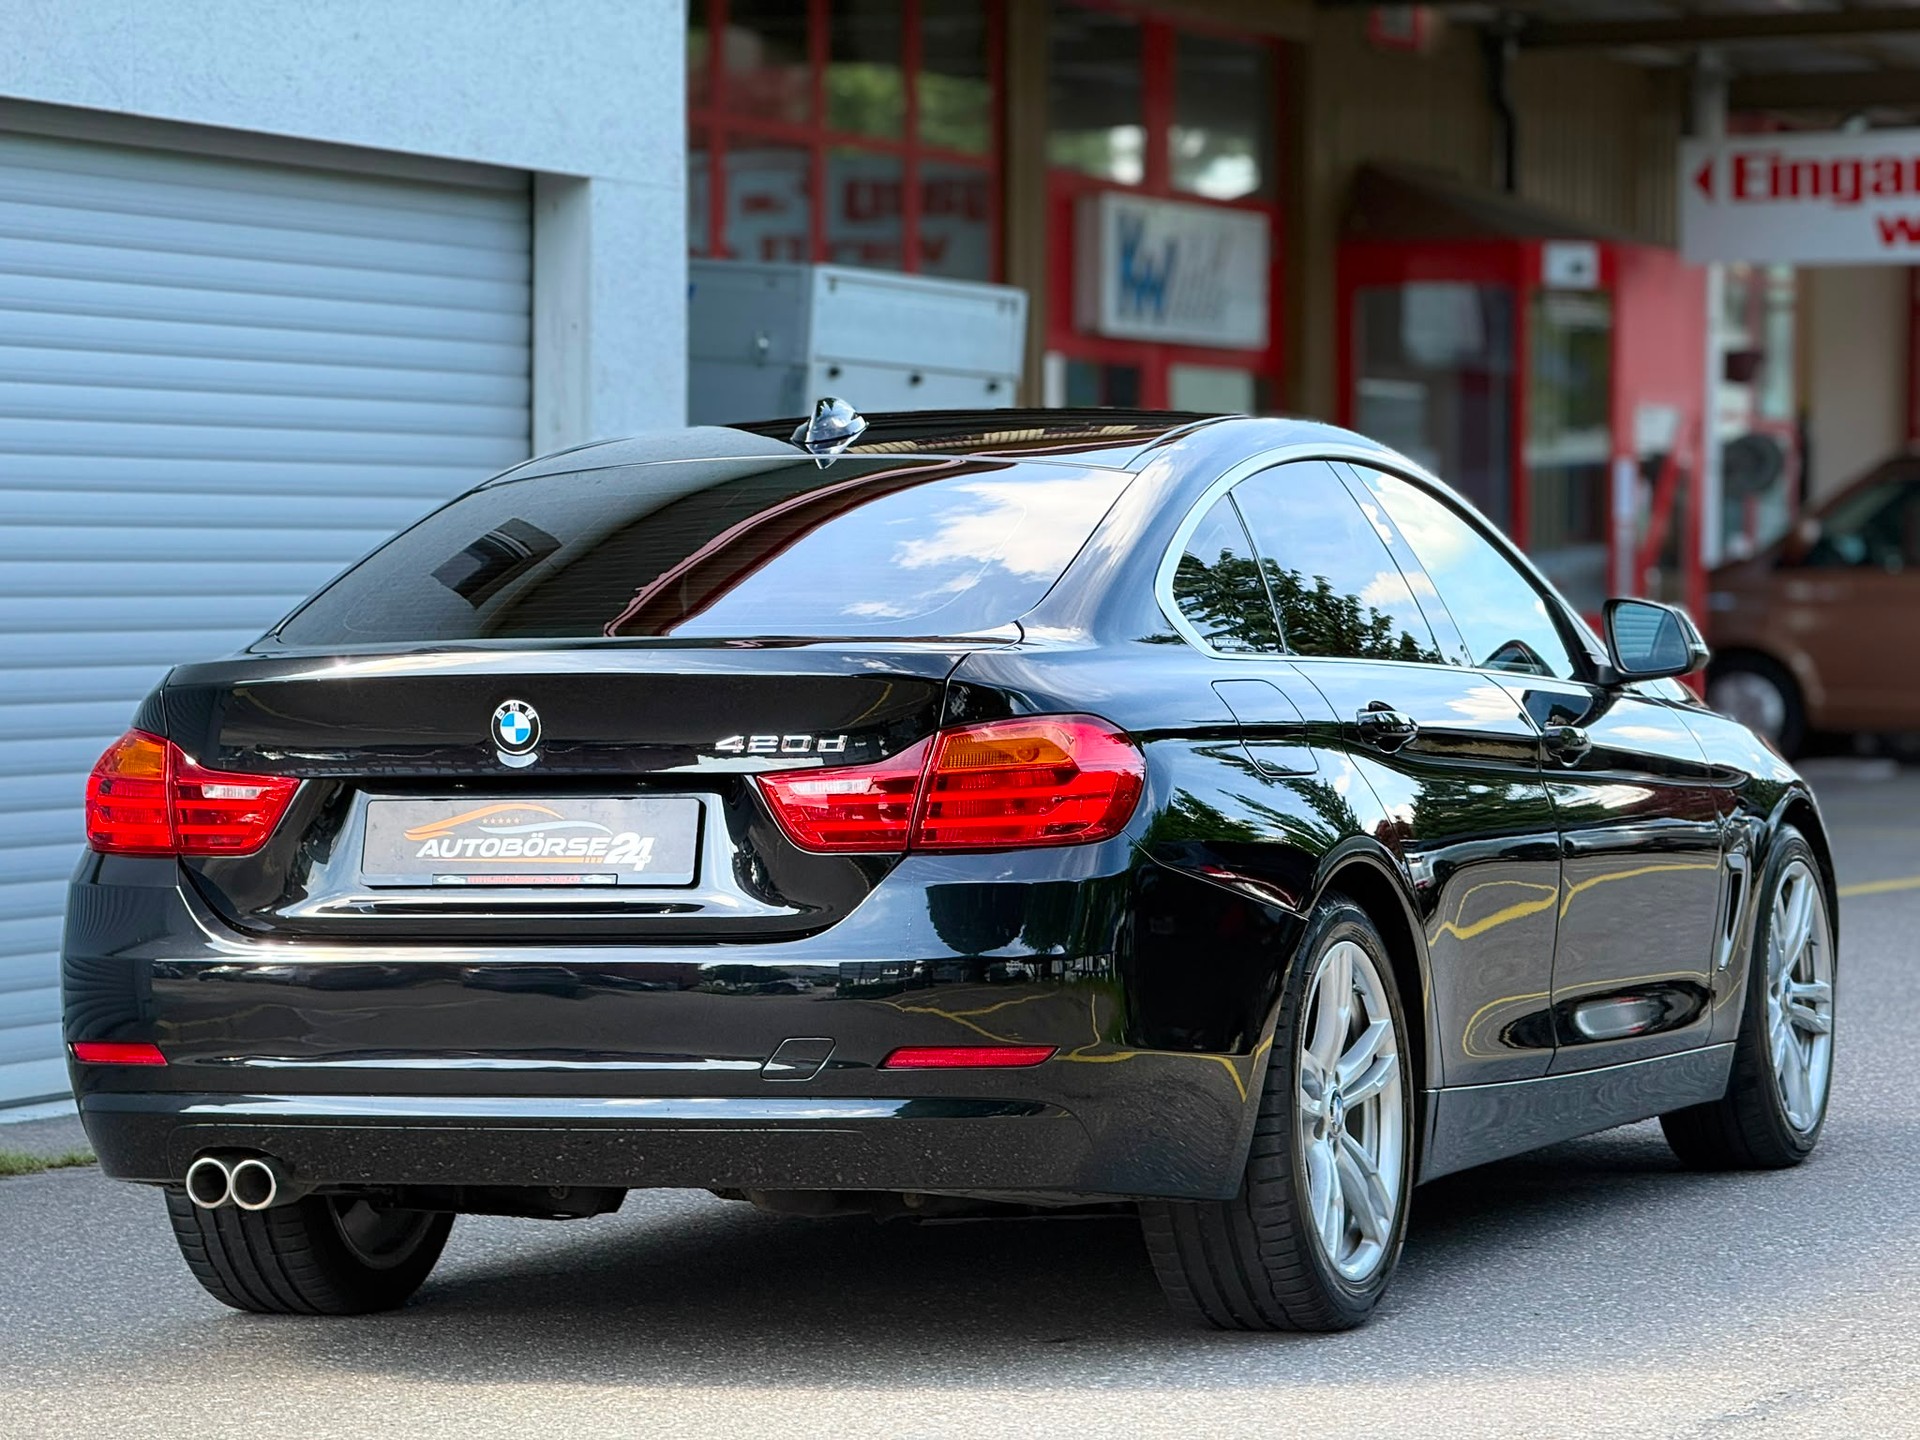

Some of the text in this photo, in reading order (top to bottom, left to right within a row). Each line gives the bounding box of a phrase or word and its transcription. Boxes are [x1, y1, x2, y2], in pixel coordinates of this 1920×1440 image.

[1732, 151, 1920, 206] Einga
[495, 701, 536, 720] BMW
[715, 735, 848, 753] 420d
